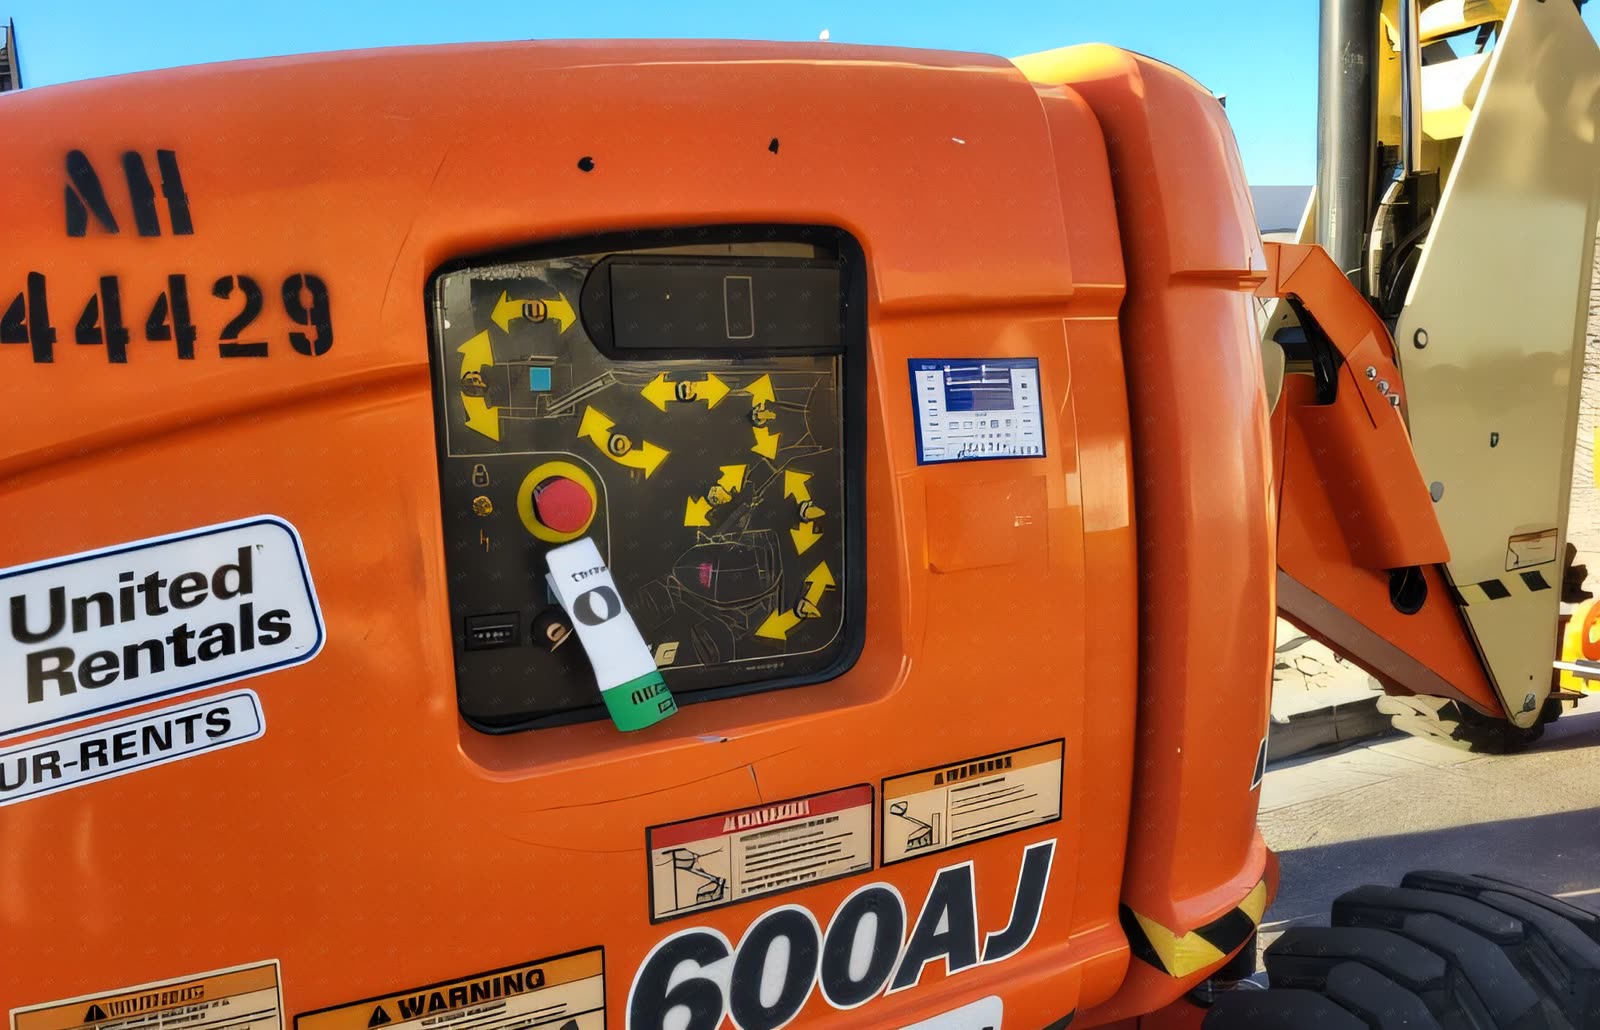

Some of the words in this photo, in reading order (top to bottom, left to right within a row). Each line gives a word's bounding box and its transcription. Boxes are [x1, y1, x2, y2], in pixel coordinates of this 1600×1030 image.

[0, 271, 333, 363] 44429
[10, 545, 253, 644] United
[27, 602, 292, 704] Rentals
[0, 707, 231, 791] UR-RENTS
[626, 838, 1057, 1030] 600AJ
